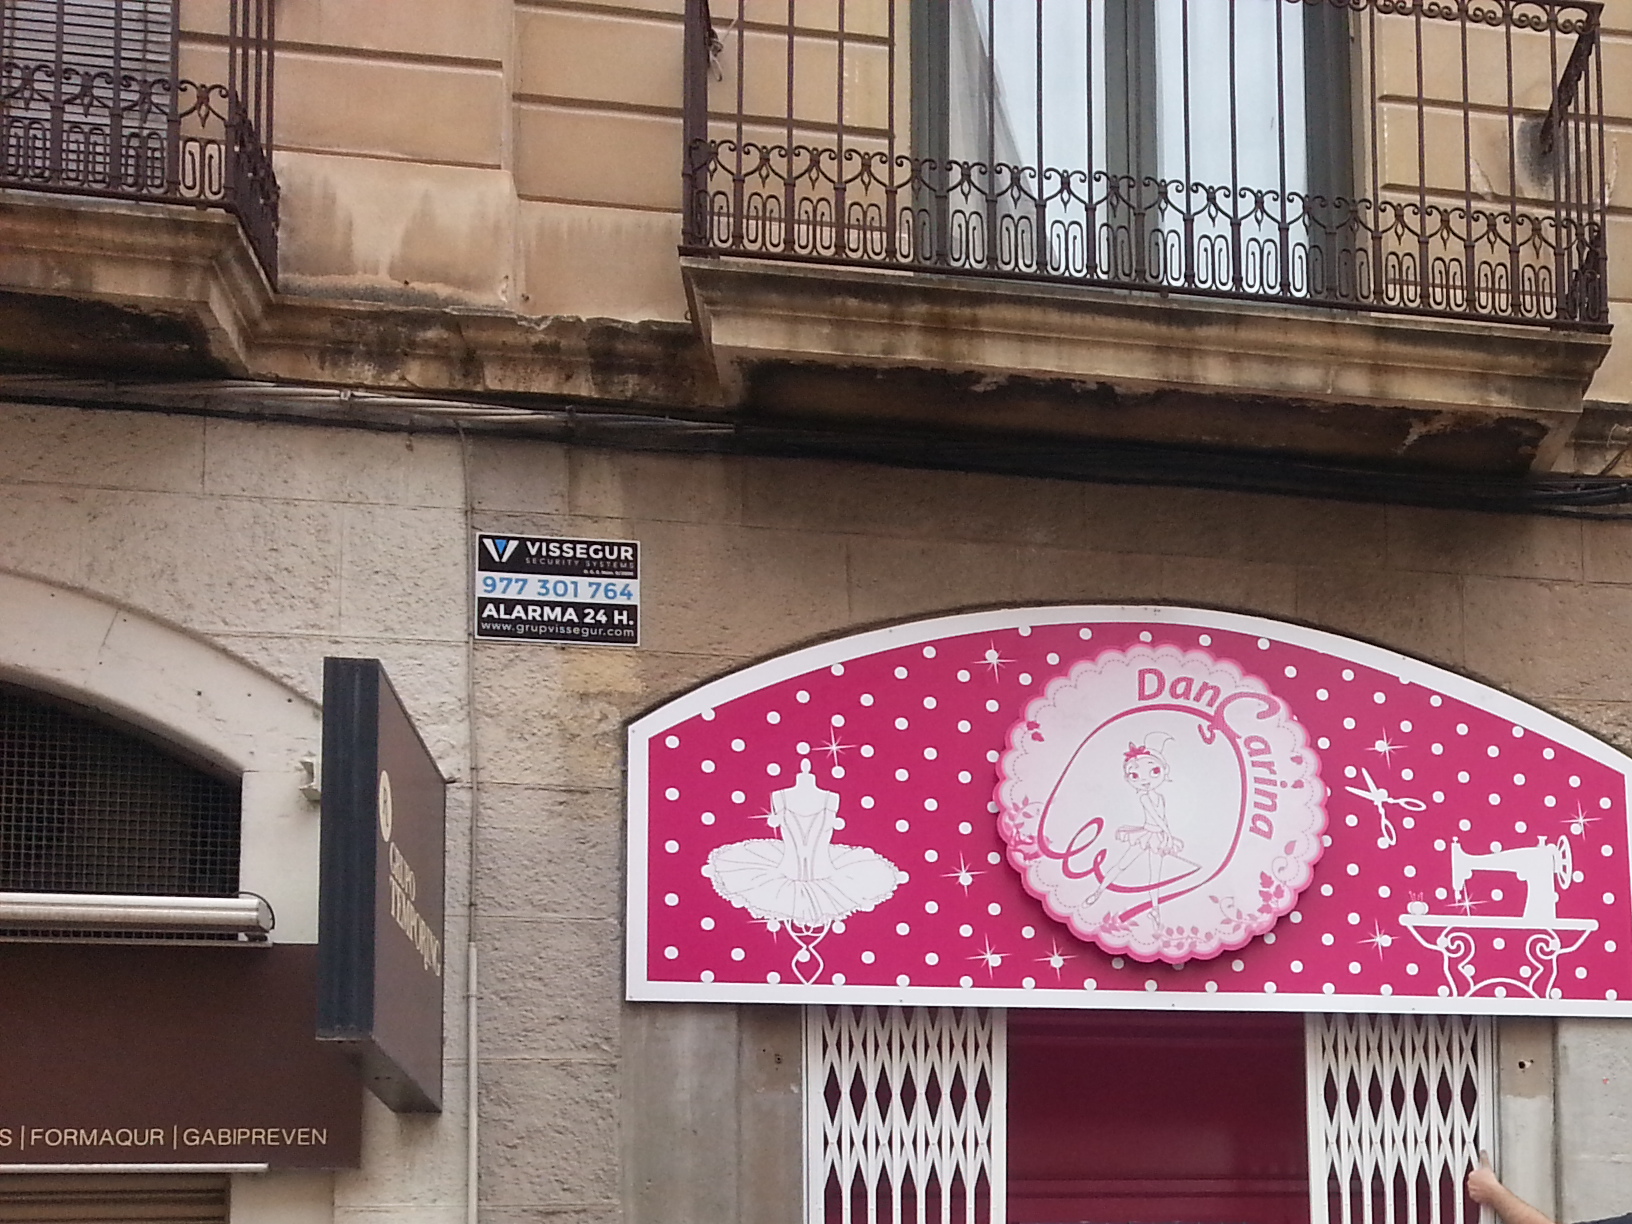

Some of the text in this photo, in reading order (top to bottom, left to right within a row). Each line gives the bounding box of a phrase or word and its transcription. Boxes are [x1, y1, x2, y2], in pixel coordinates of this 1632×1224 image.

[525, 540, 634, 561] VISSEGUR
[525, 557, 635, 570] SECURITY SYSTEMS
[482, 575, 634, 601] 977 301 764
[481, 602, 635, 626] ALARMA 24 H.
[480, 621, 635, 638] www.grupvissegur.com
[30, 1128, 164, 1147] FORMAQUR
[182, 1127, 328, 1146] GABIPREVEN
